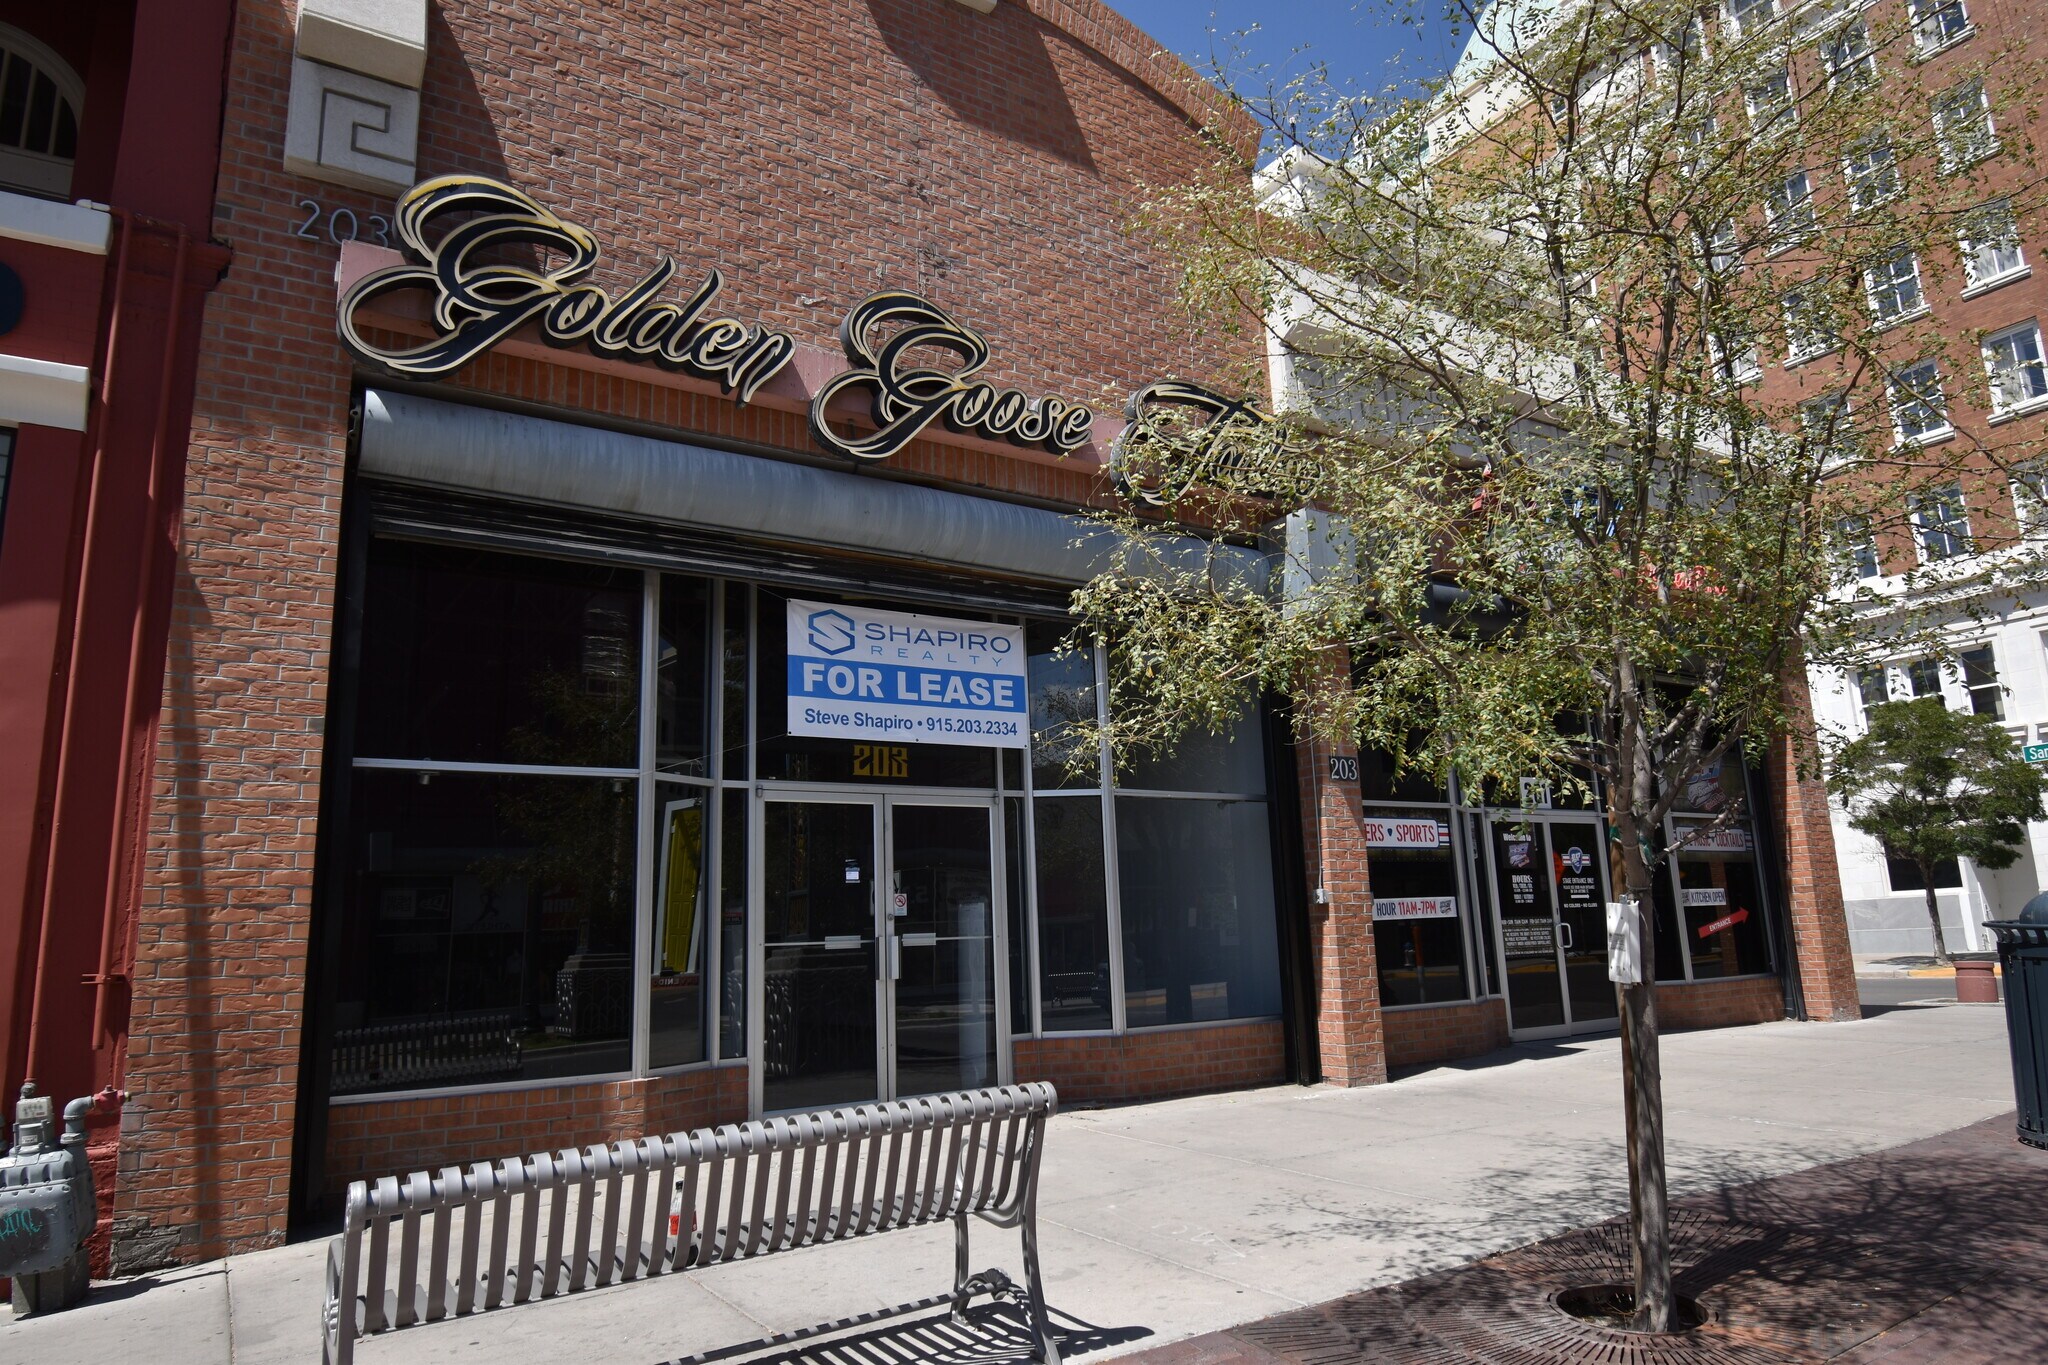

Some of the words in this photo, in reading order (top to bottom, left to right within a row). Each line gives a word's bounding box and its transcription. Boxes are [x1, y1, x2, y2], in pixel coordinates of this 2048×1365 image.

[297, 200, 389, 247] 203
[337, 173, 797, 407] Golden
[808, 289, 1095, 463] Goose
[865, 622, 1012, 654] SHAPIRO
[870, 645, 1003, 668] REALTY
[803, 661, 885, 699] FOR
[897, 671, 1015, 708] LEASE
[804, 708, 850, 726] Steve
[854, 711, 914, 732] Shapiro
[926, 716, 1018, 736] 915.203.2334
[853, 745, 909, 778] 203
[1330, 758, 1358, 780] 203
[1396, 824, 1435, 843] SPORTS
[1502, 832, 1526, 841] Welcme
[1715, 832, 1744, 848] COCKTAILS
[1376, 902, 1397, 916] HOUR
[1398, 900, 1437, 916] 11AM-7PM
[1691, 891, 1712, 904] KITCHEN
[1712, 890, 1726, 903] OPEN
[1709, 917, 1732, 932] ENTRANCE
